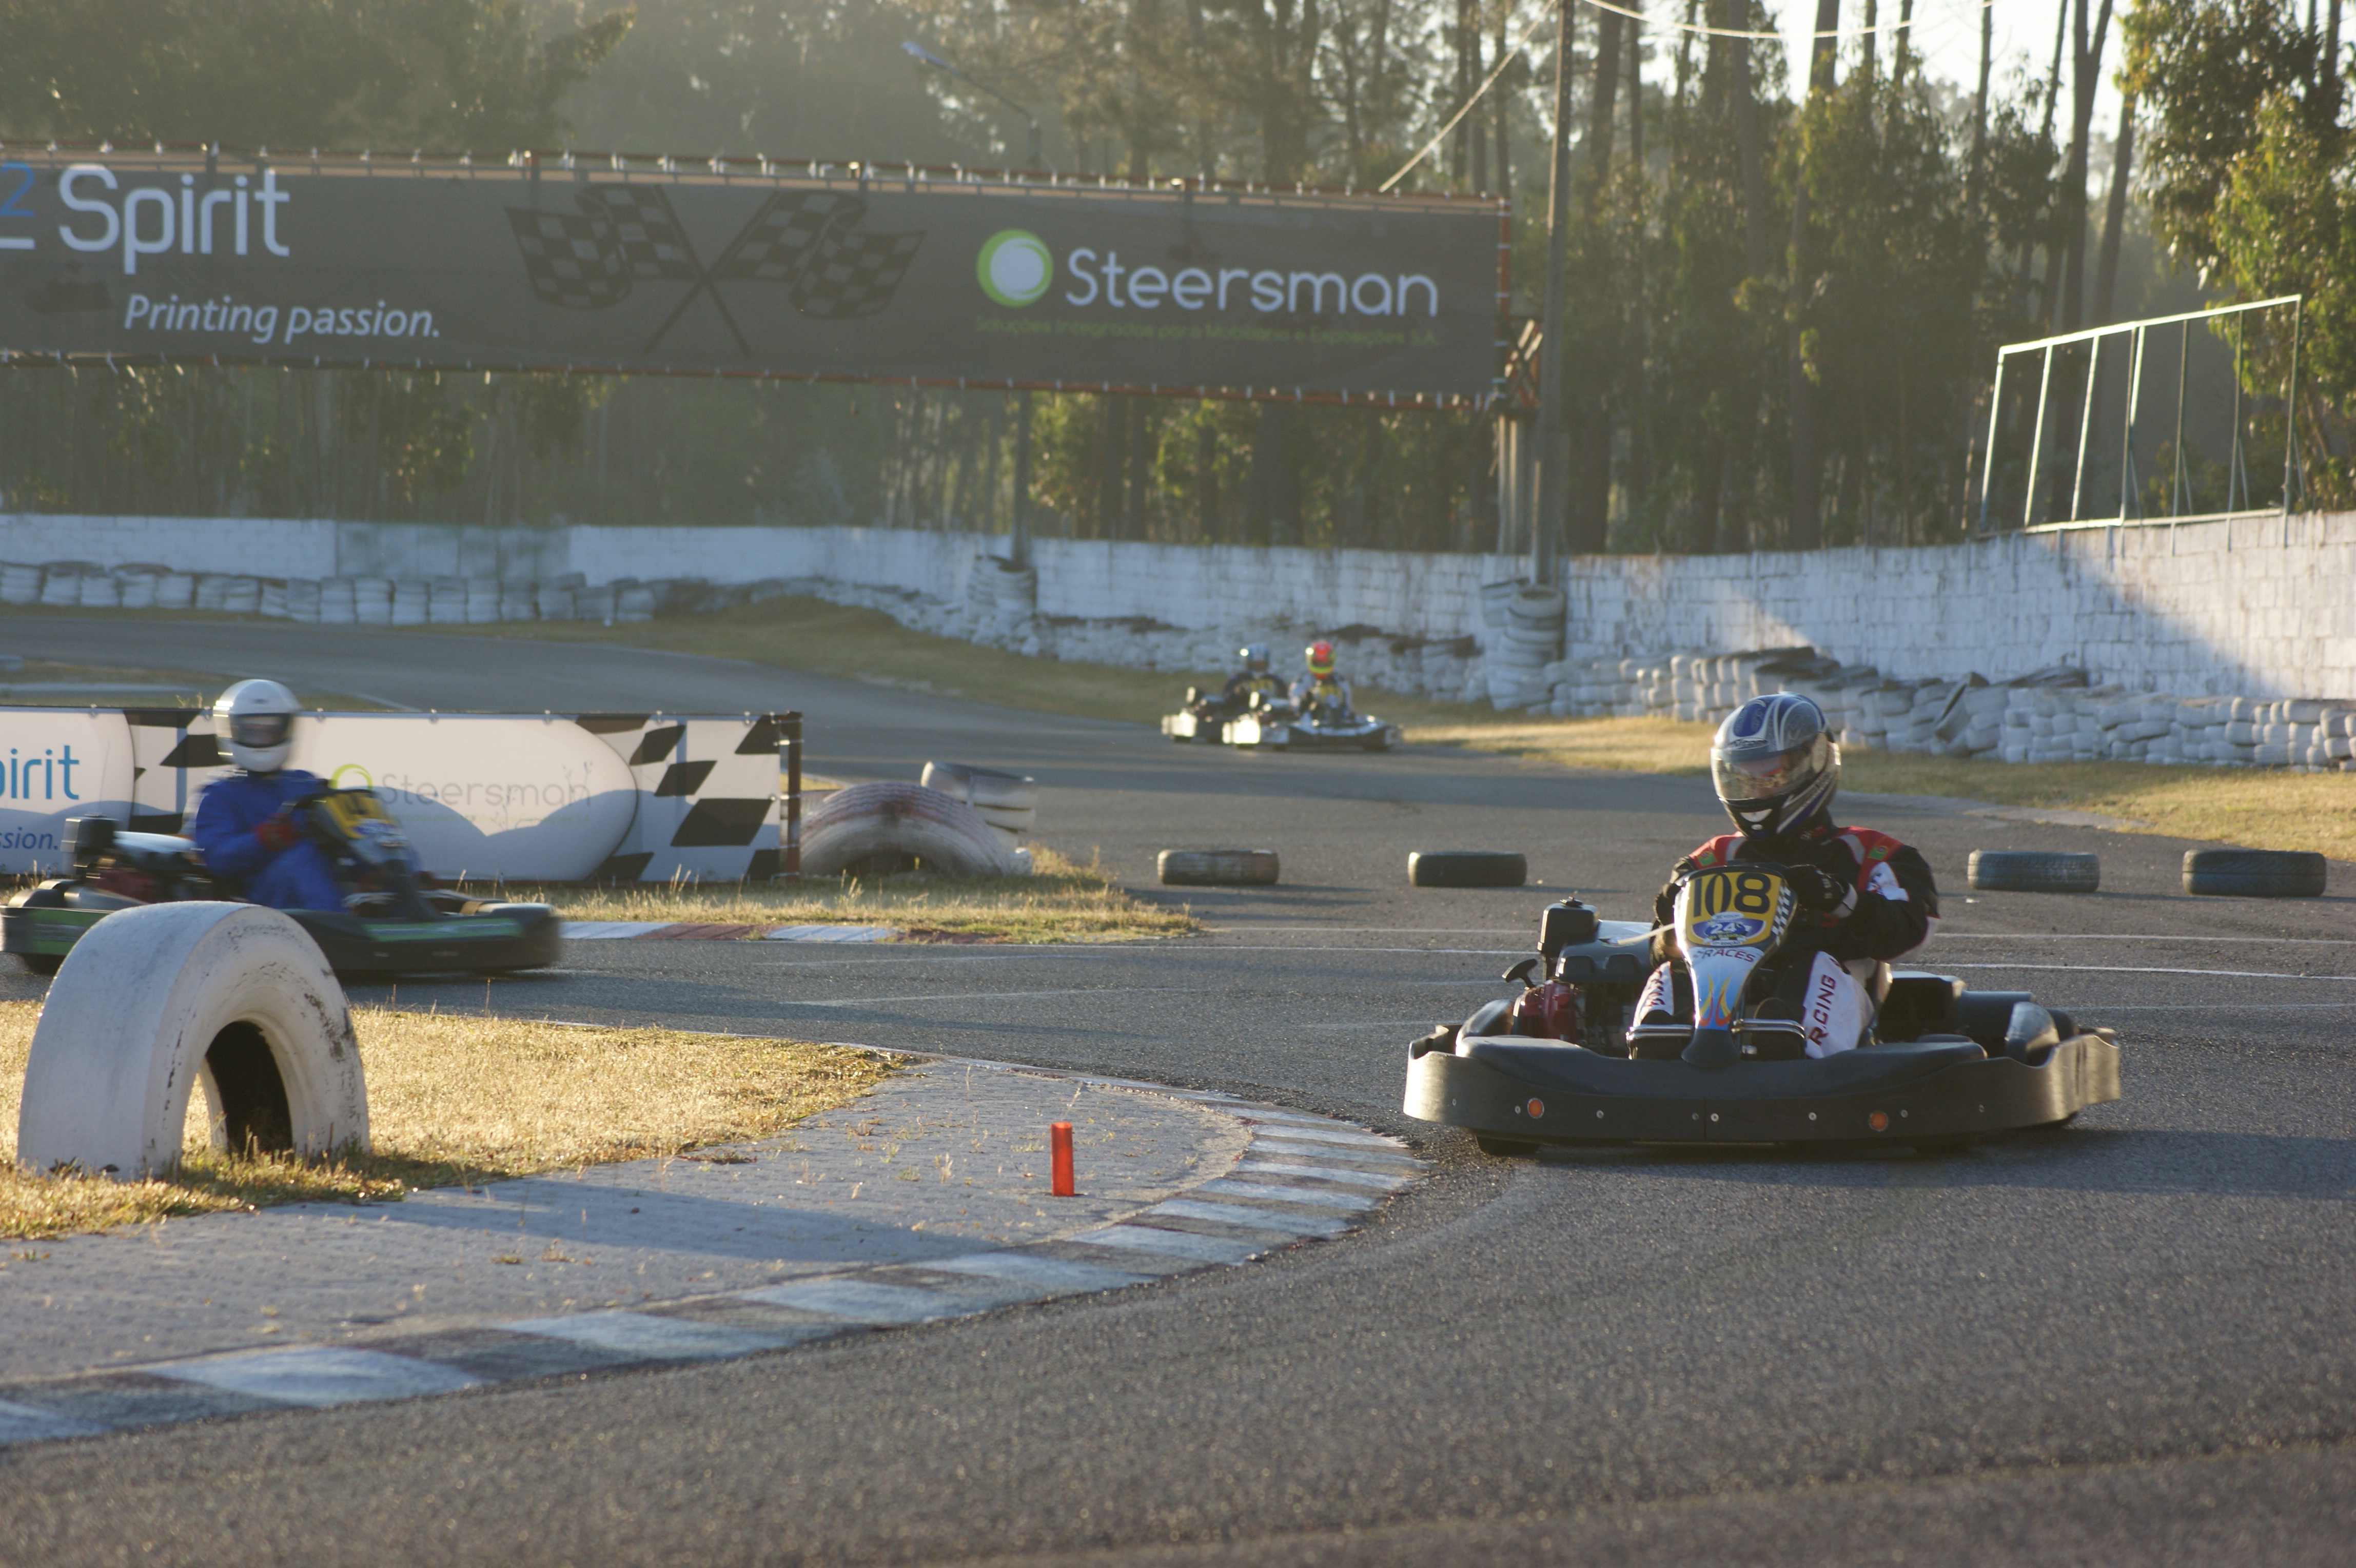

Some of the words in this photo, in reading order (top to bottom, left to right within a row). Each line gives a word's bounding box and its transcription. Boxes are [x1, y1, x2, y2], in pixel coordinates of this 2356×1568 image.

[59, 163, 291, 275] Spirit
[1066, 247, 1439, 317] Steersman
[124, 293, 279, 344] Printing
[284, 299, 440, 345] passion.
[0, 745, 79, 800] irit
[381, 773, 592, 806] Steersman
[0, 827, 58, 850] sion.
[1693, 872, 1772, 918] 108
[1710, 922, 1737, 934] 24
[1808, 974, 1836, 1047] RCING
